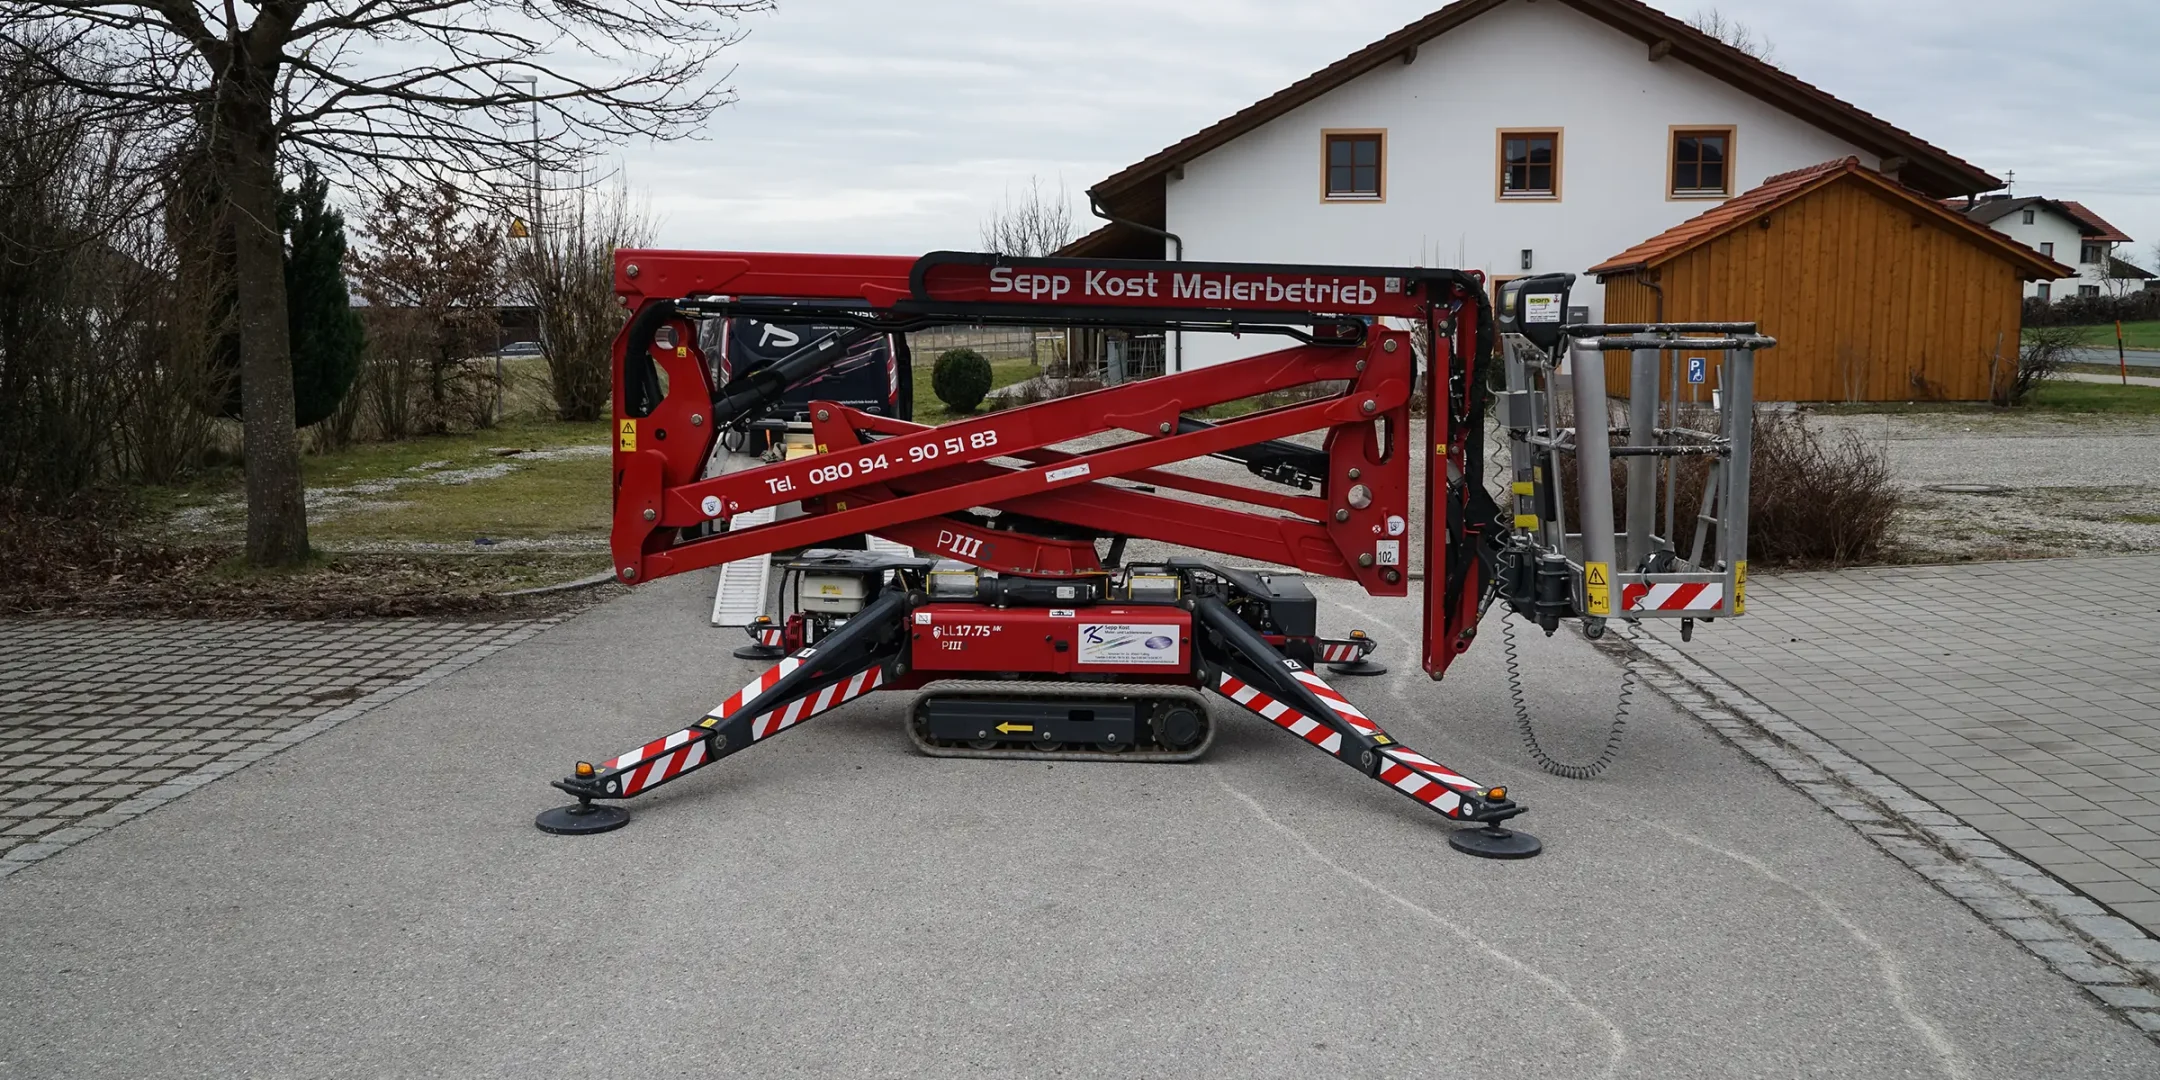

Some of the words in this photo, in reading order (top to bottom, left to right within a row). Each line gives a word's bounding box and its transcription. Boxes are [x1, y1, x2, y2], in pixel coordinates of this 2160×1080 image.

[990, 267, 1071, 300] Sepp
[1085, 270, 1159, 297] Kost
[1172, 273, 1377, 305] Malerbetrieb
[1691, 360, 1700, 371] P
[765, 476, 797, 494] Tel.
[809, 462, 853, 485] 080
[858, 454, 889, 474] 94
[909, 443, 939, 463] 90
[970, 430, 998, 449] 83
[1378, 551, 1392, 563] 102
